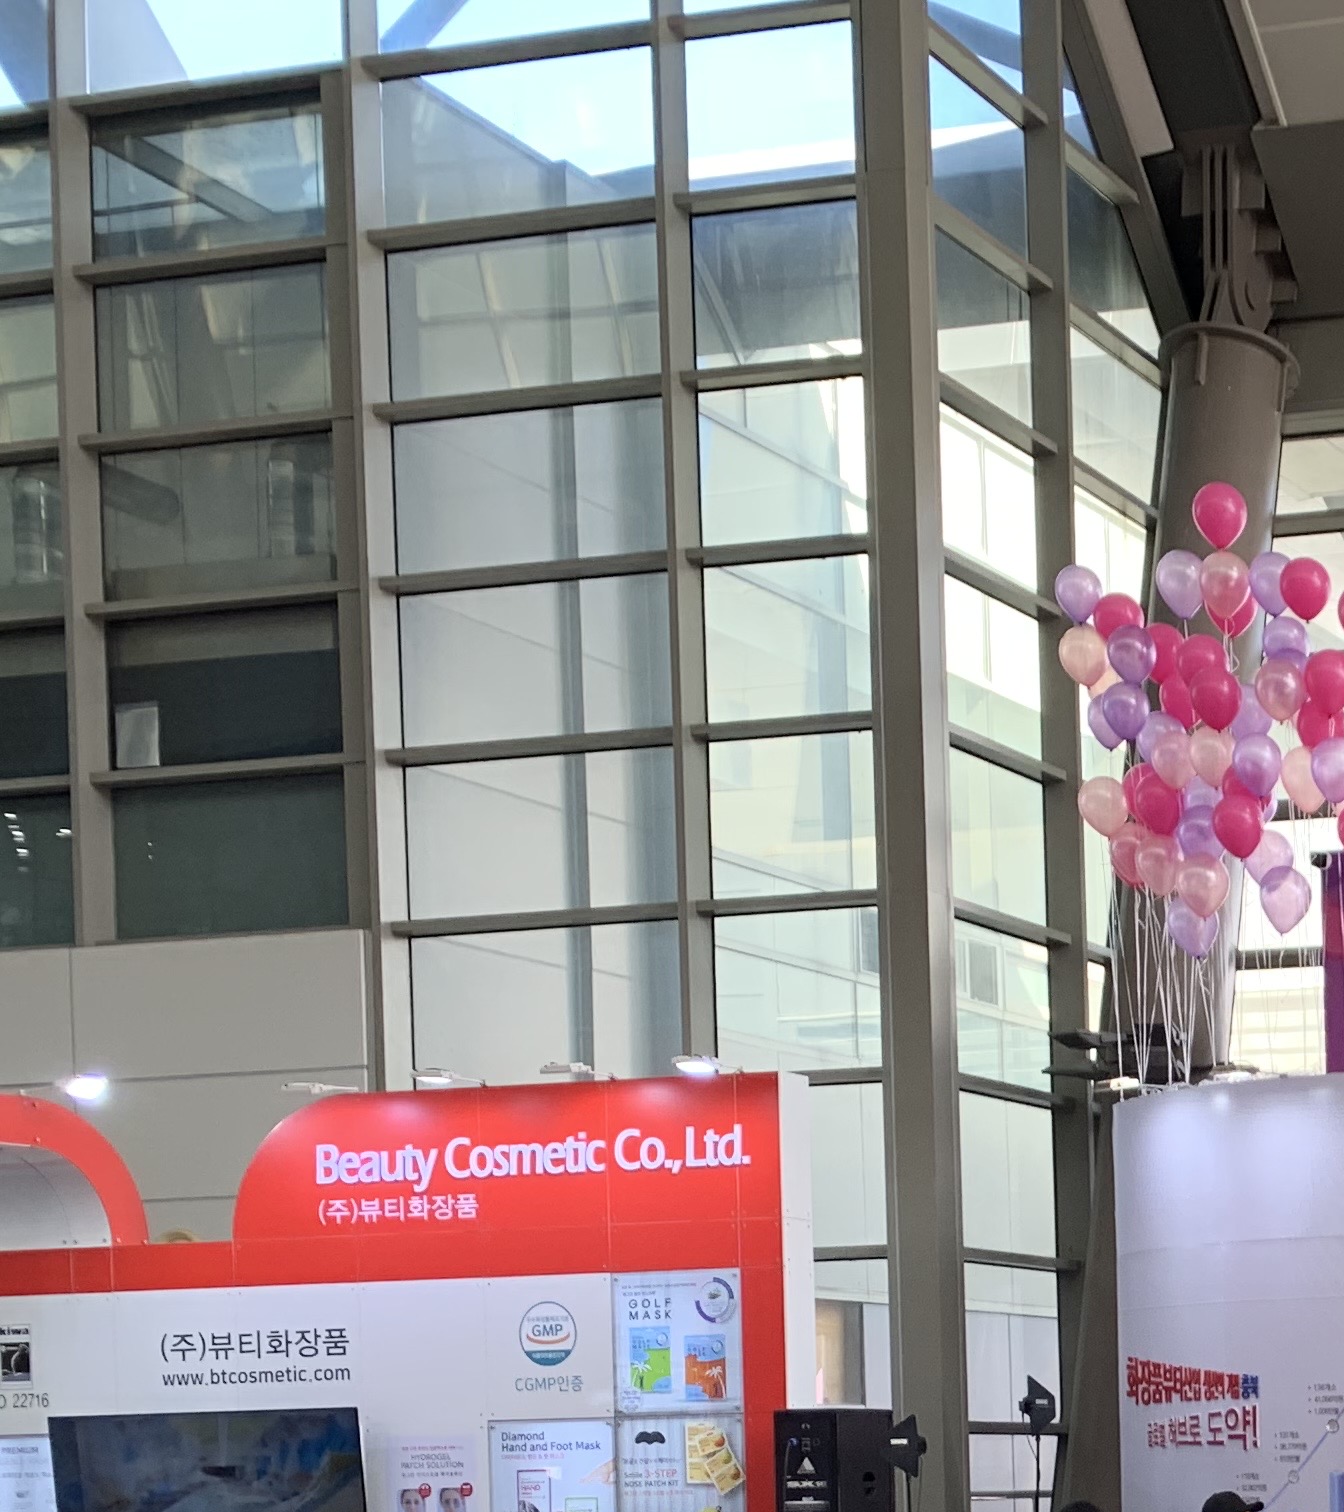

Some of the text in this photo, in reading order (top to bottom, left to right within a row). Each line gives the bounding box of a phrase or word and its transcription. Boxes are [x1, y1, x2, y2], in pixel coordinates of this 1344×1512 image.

[315, 1143, 438, 1192] Beauty
[444, 1132, 606, 1180] Cosmetic
[318, 1193, 479, 1226] (주)뷰티화장품
[628, 1298, 672, 1309] GOLF
[628, 1309, 672, 1320] MASK
[531, 1323, 563, 1337] GMP
[160, 1327, 350, 1363] (주)뷰티화장품
[162, 1365, 351, 1386] www.btcosmetic.com
[515, 1375, 584, 1392] CGMP인증
[13, 1393, 49, 1409] 22716
[501, 1431, 545, 1441] Diamond
[1206, 1404, 1260, 1452] 도약!
[501, 1441, 601, 1452] Hand and Foot Mask
